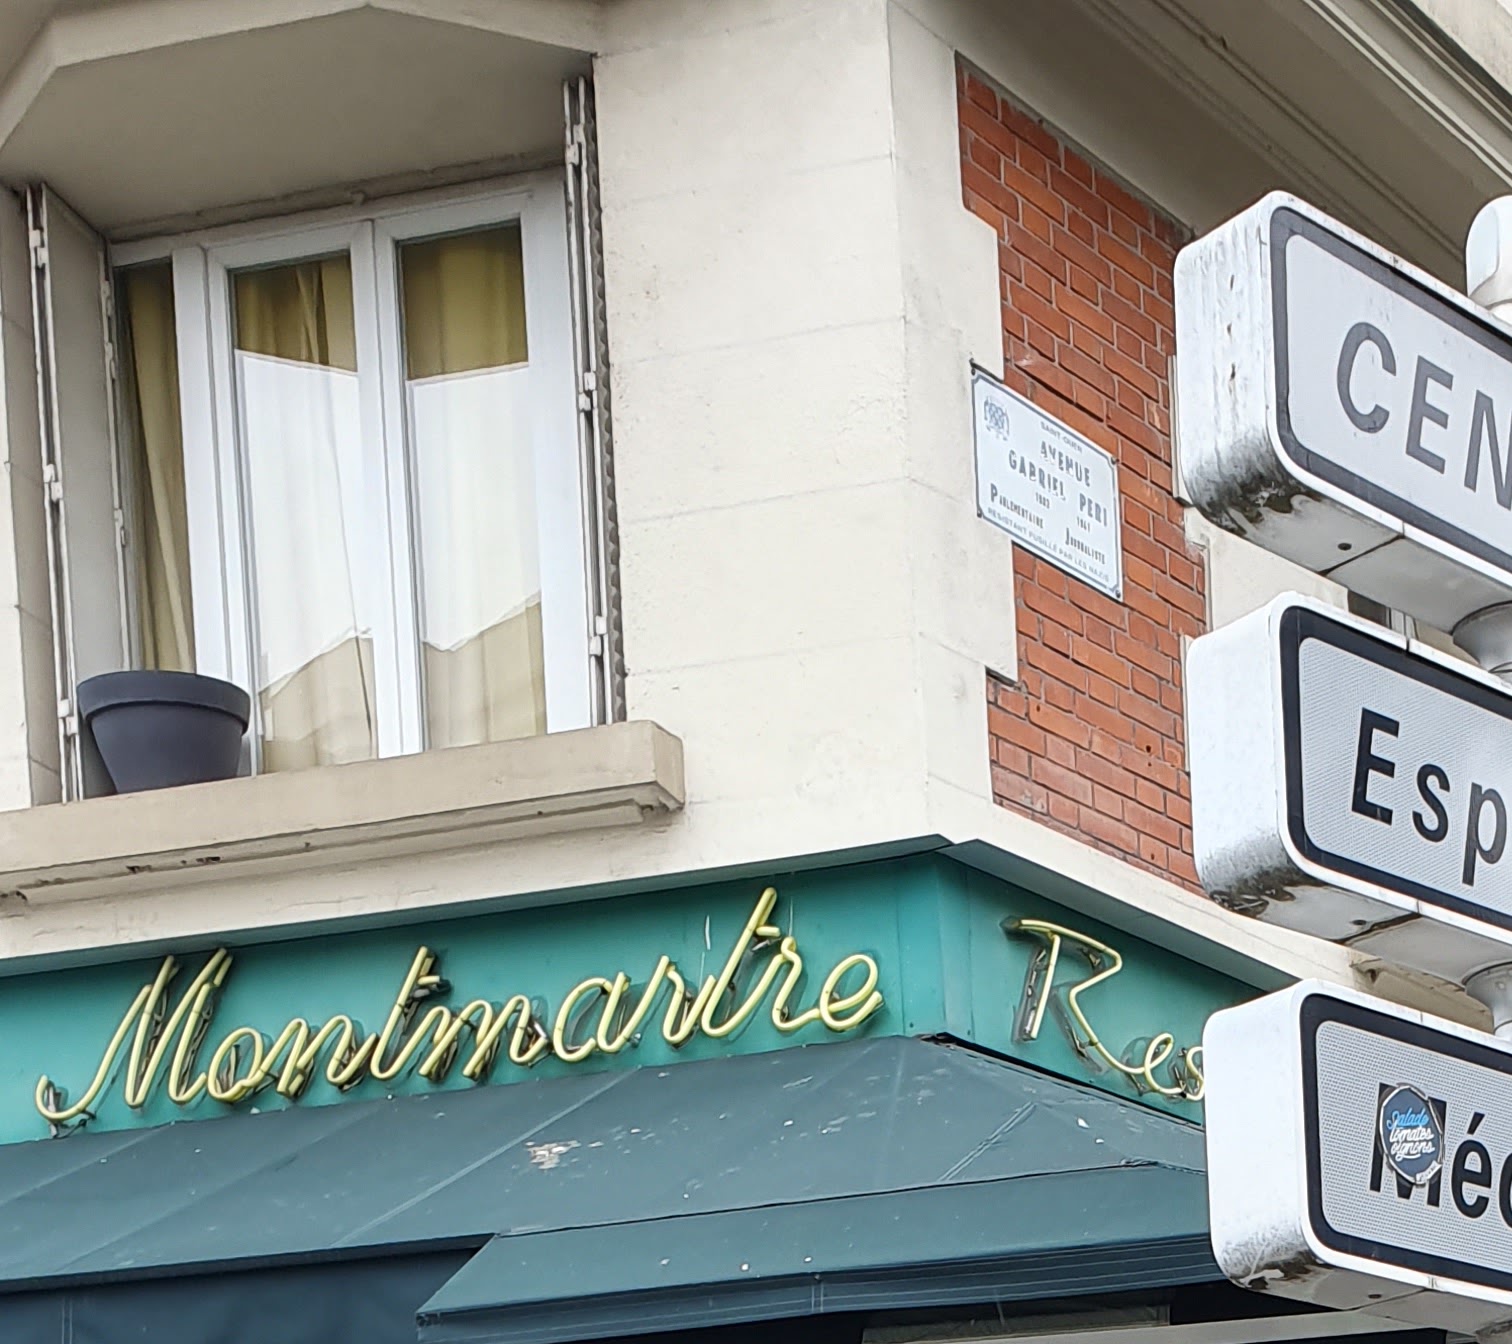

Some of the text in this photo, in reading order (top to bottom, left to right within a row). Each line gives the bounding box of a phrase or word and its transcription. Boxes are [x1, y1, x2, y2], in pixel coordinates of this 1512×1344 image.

[1008, 449, 1065, 497] GABRIEL
[1041, 441, 1091, 487] AVENUE
[35, 887, 884, 1122] Montmartre
